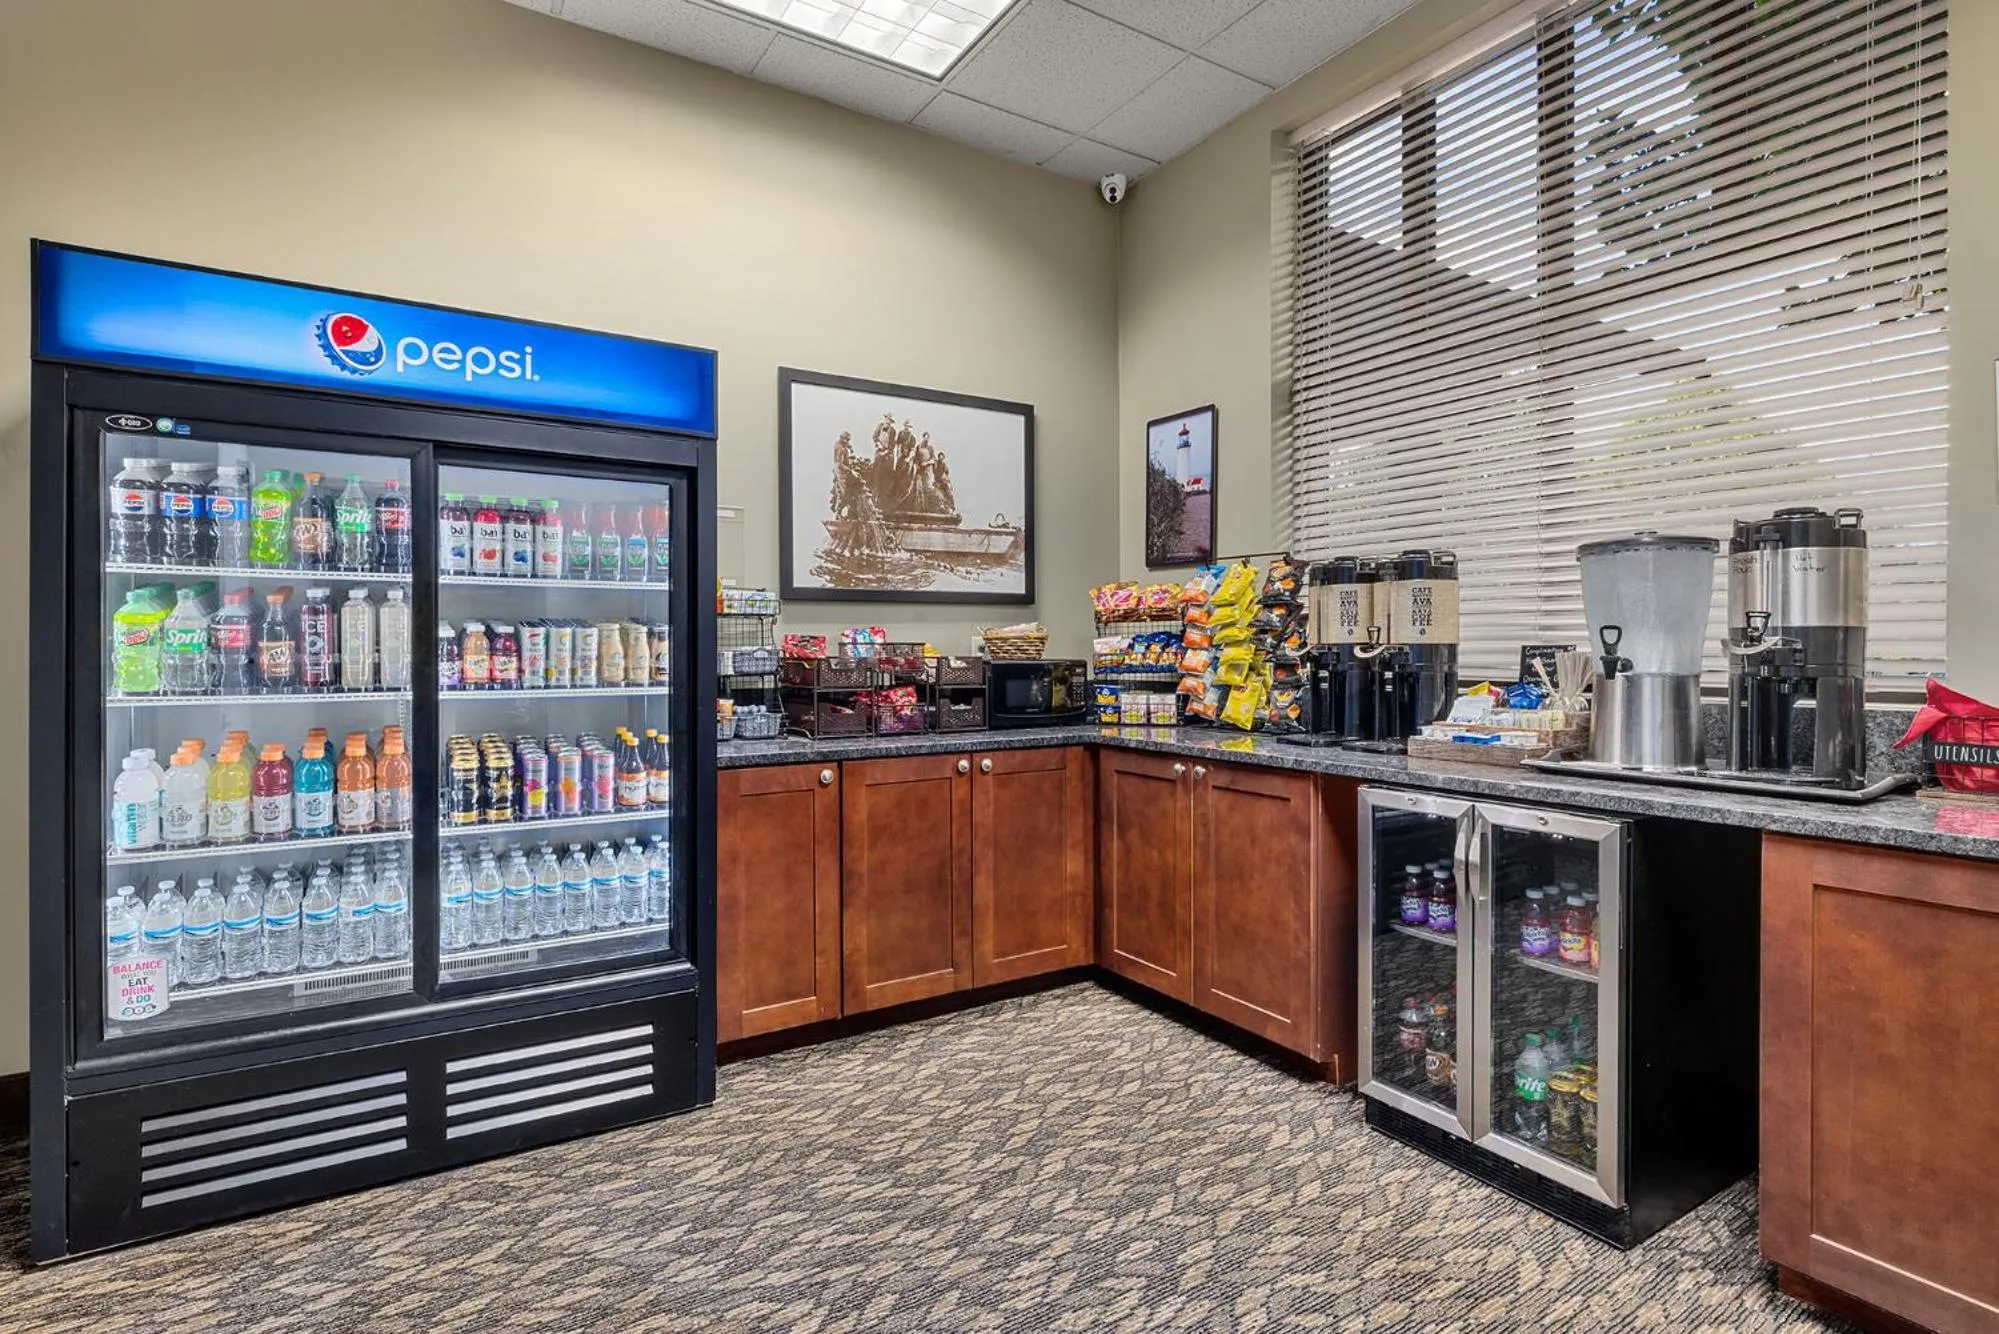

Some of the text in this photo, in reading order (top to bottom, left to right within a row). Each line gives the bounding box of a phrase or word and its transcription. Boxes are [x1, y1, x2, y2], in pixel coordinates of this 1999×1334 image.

[396, 336, 533, 382] pepsi
[301, 621, 326, 633] ICE
[1934, 744, 1999, 765] UTENSILS
[112, 960, 164, 974] BALANCE
[128, 976, 149, 987] EAT
[122, 984, 155, 997] DRINK
[136, 994, 151, 1003] DO
